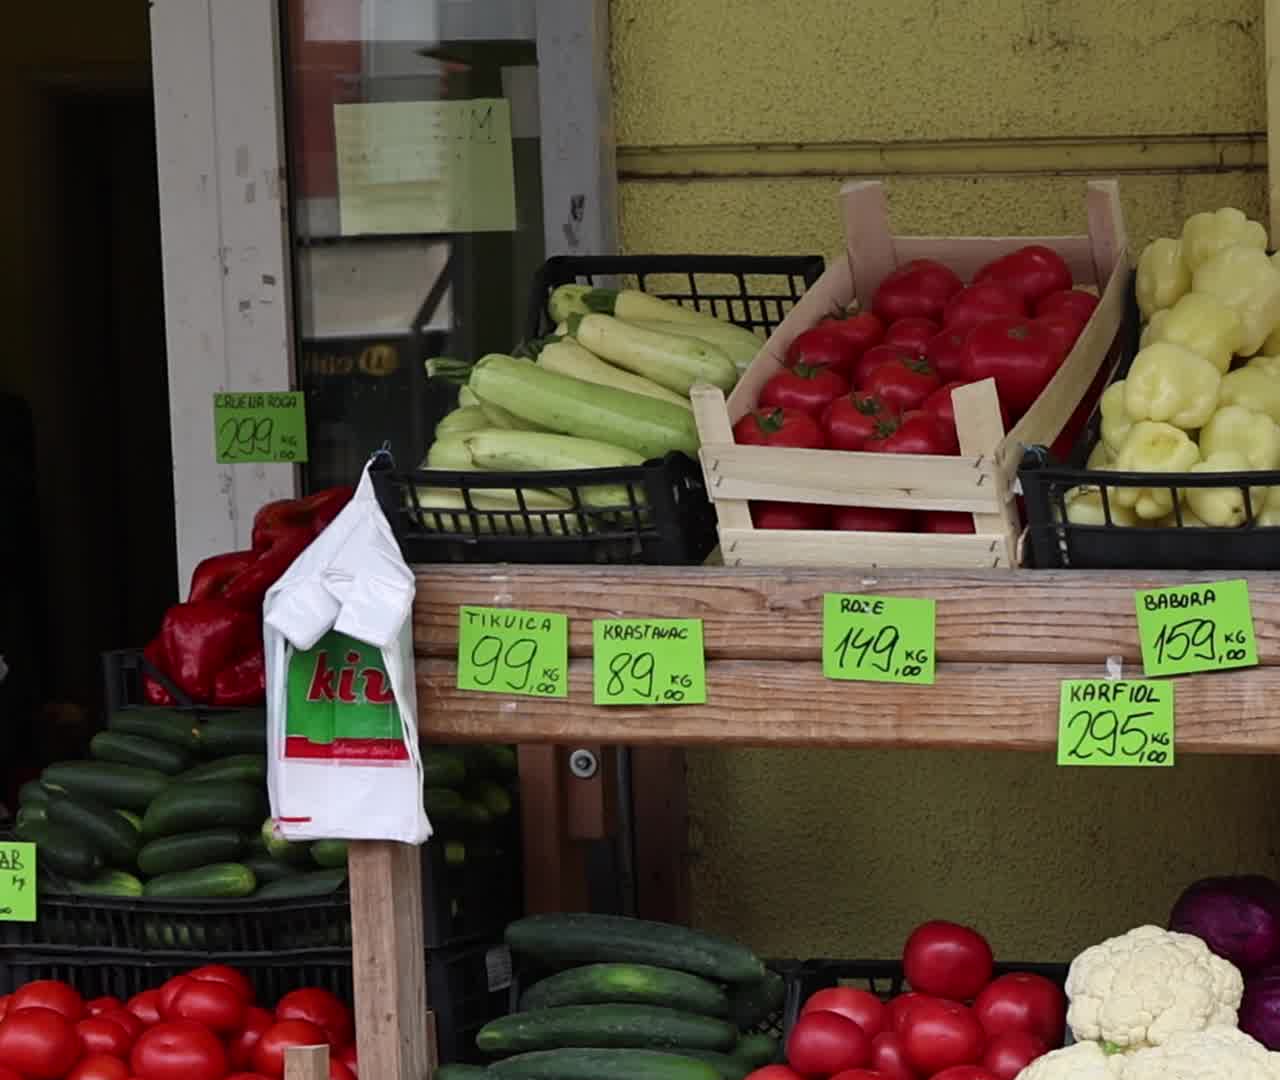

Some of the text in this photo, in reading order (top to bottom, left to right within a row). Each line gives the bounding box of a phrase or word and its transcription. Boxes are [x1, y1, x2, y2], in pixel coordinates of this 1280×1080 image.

[1225, 630, 1247, 643] KG
[904, 649, 929, 664] KG
[543, 667, 560, 682] KG
[670, 674, 693, 688] KG
[1071, 683, 1160, 703] KARFIOL
